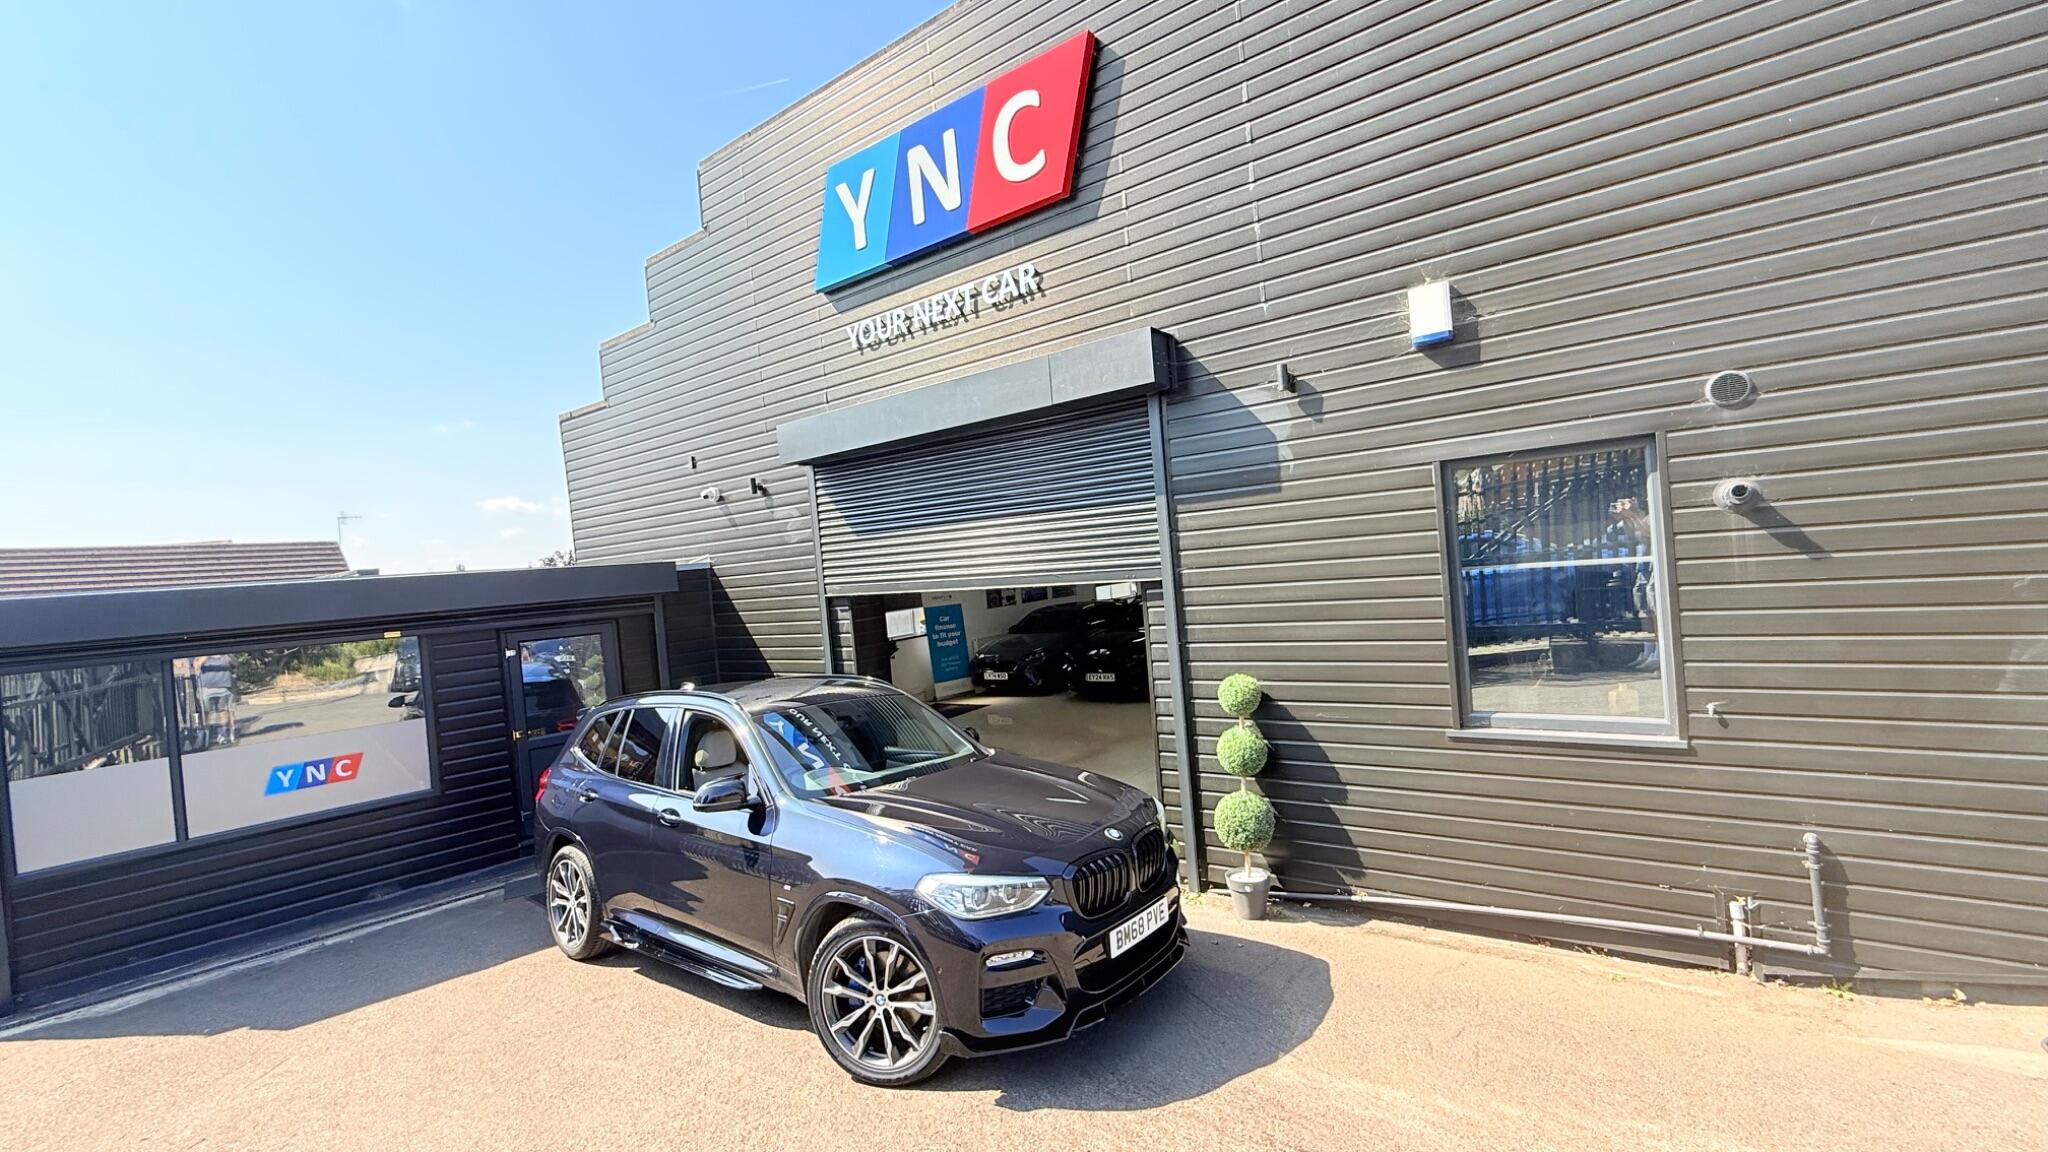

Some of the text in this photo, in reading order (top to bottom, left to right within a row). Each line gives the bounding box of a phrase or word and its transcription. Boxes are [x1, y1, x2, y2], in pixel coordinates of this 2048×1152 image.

[834, 89, 1047, 251] YNC
[846, 262, 1039, 350] YOUR NEXT CAR
[276, 759, 354, 788] YNC
[1115, 901, 1166, 951] BM68 PVE
